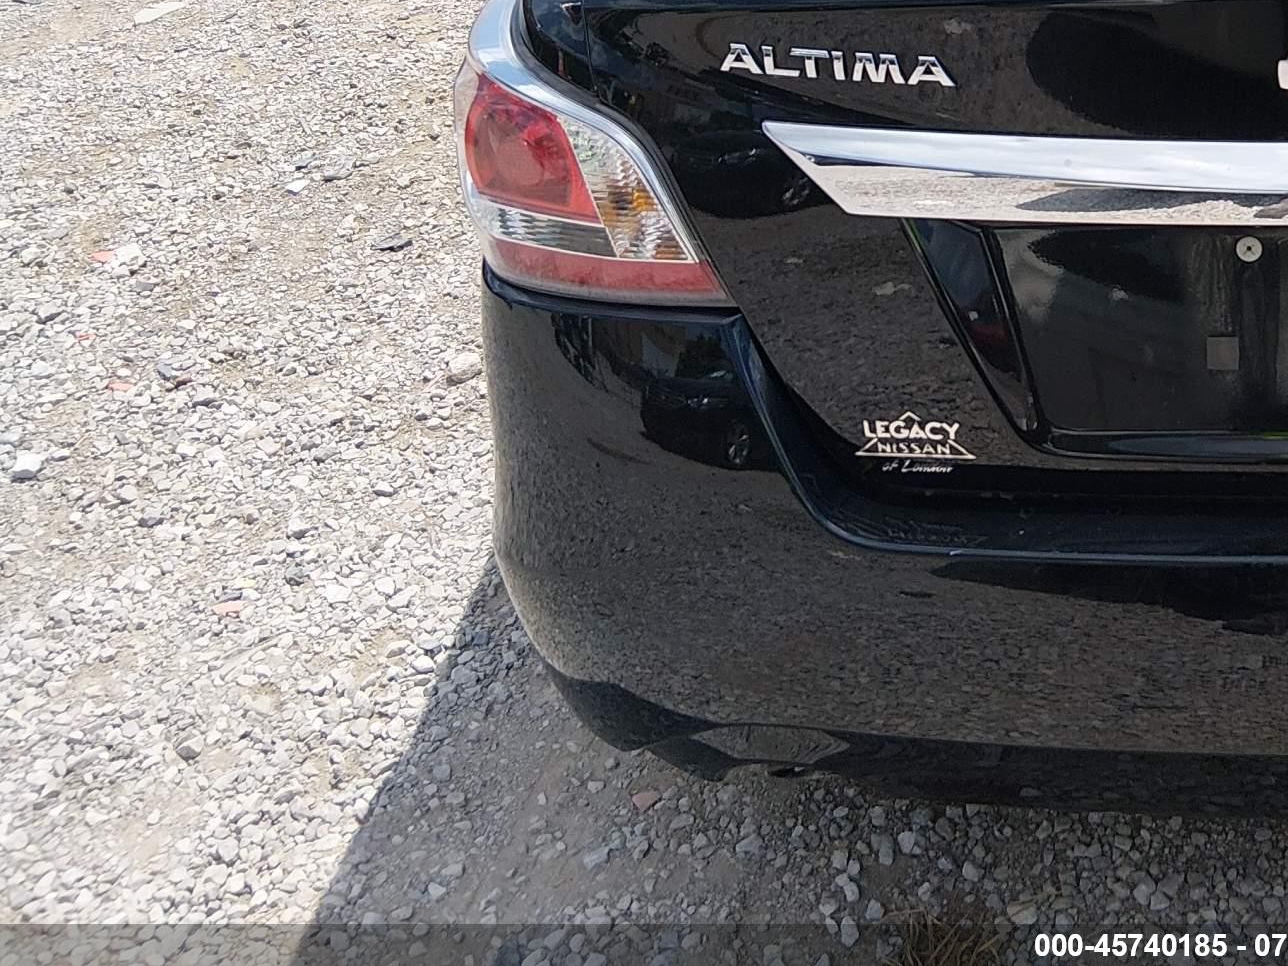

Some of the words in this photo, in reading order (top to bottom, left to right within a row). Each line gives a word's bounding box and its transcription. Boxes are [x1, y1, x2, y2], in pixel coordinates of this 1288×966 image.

[720, 43, 956, 87] ALTIMA
[863, 419, 960, 440] LEGACY
[877, 441, 951, 455] NISSAN
